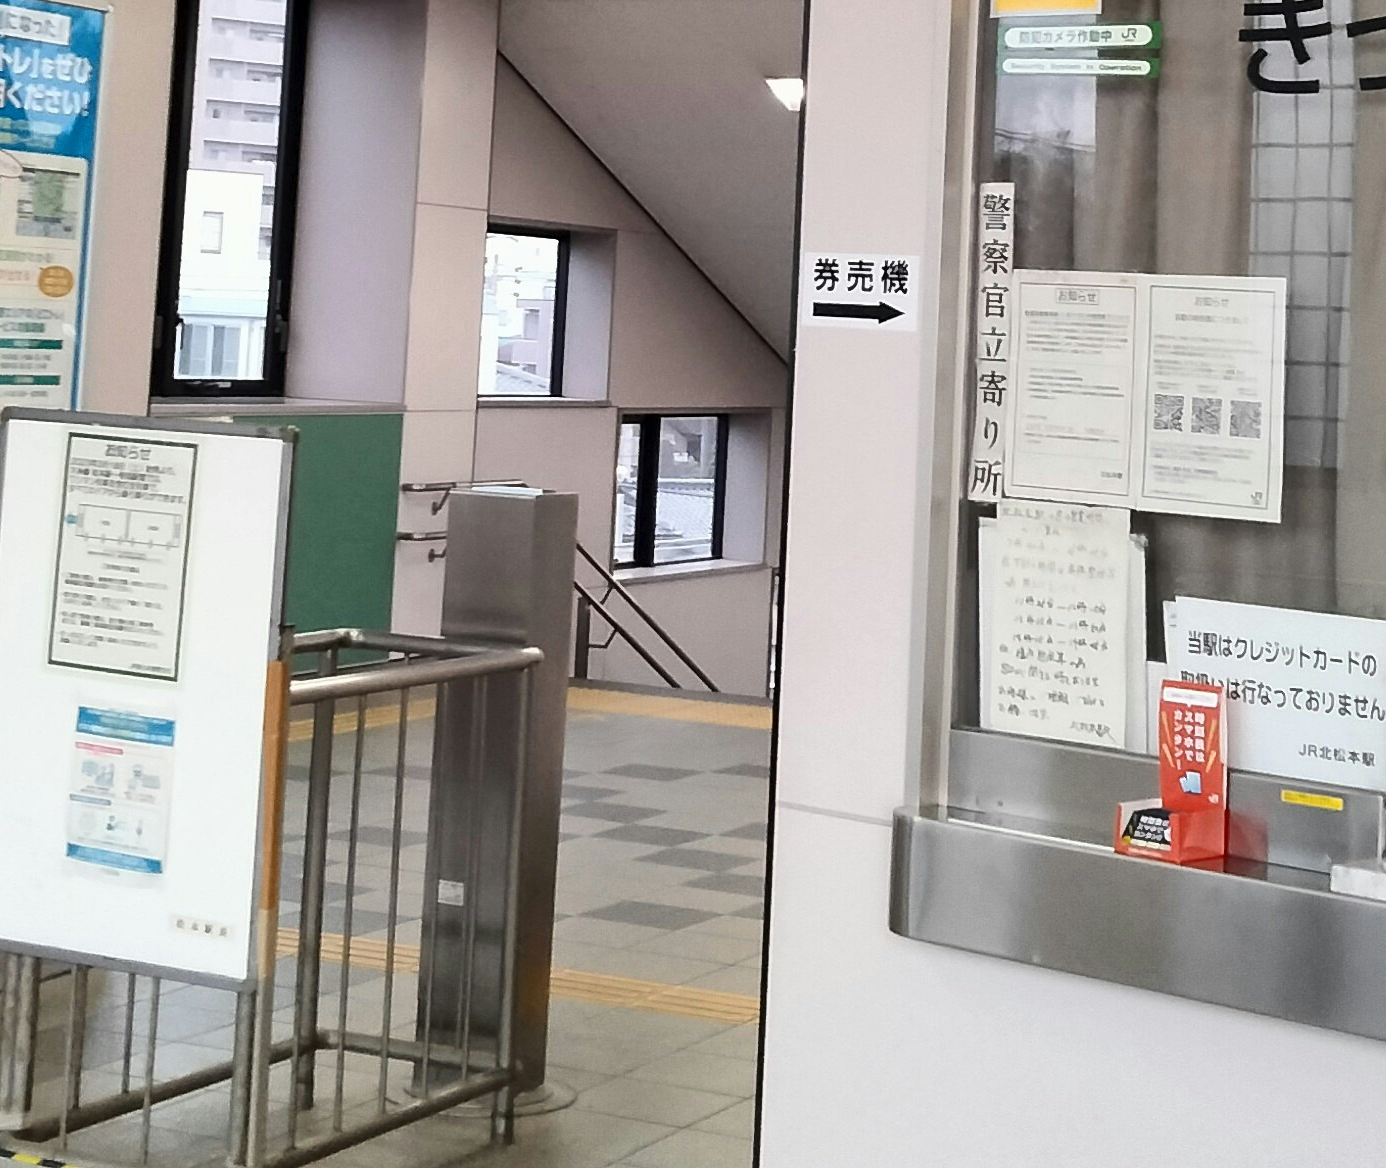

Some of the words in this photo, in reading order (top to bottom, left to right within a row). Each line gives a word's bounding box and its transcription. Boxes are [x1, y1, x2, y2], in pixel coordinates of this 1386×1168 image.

[1121, 27, 1138, 39] JR
[813, 257, 910, 295] 券売機
[1058, 289, 1097, 303] お知らせ
[971, 193, 1011, 497] 警察官立寄り所
[1187, 630, 1377, 678] 当駅はクレジットカードの
[1299, 744, 1376, 769] JR北松本駅
